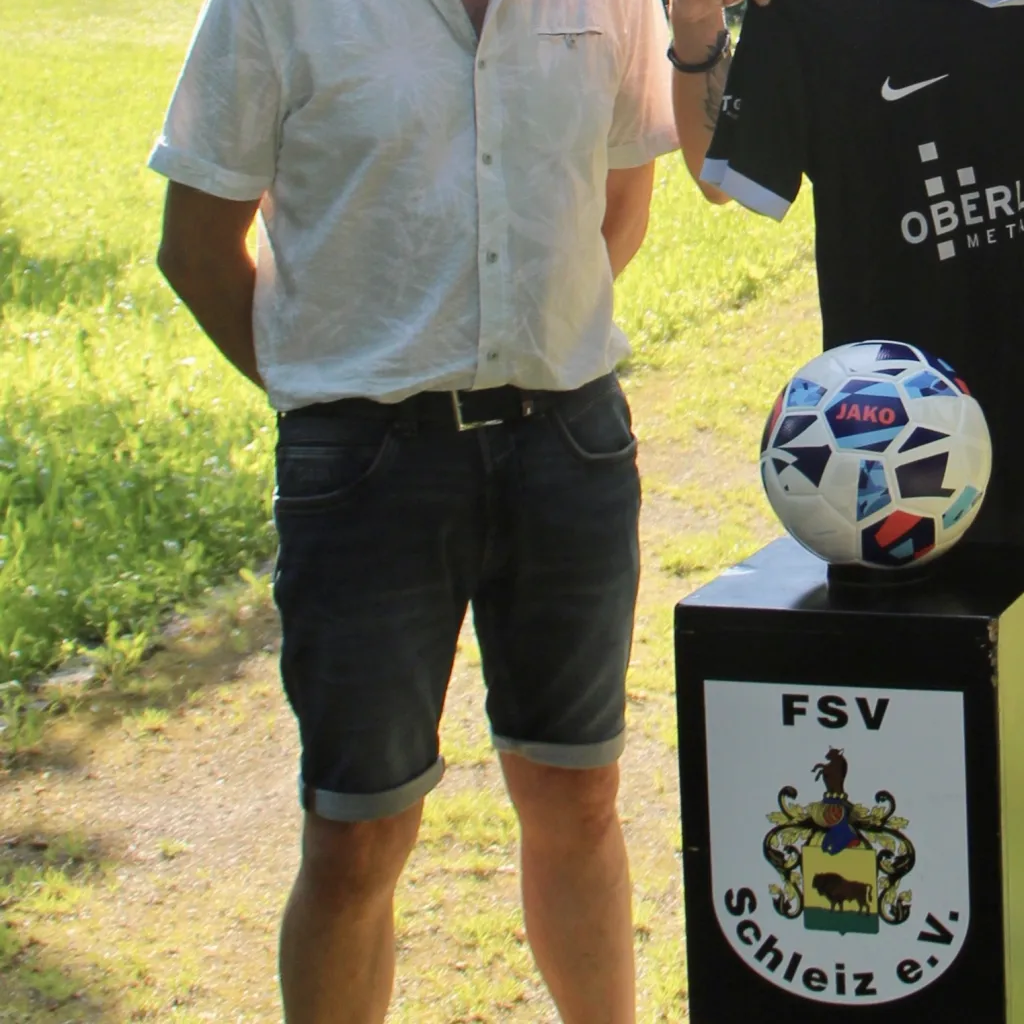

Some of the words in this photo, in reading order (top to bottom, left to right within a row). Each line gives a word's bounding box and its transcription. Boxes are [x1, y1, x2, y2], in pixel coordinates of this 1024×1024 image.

[836, 403, 896, 425] JAKO
[782, 693, 890, 731] FSV
[724, 887, 877, 996] Schleiz
[896, 910, 959, 984] e.V.
